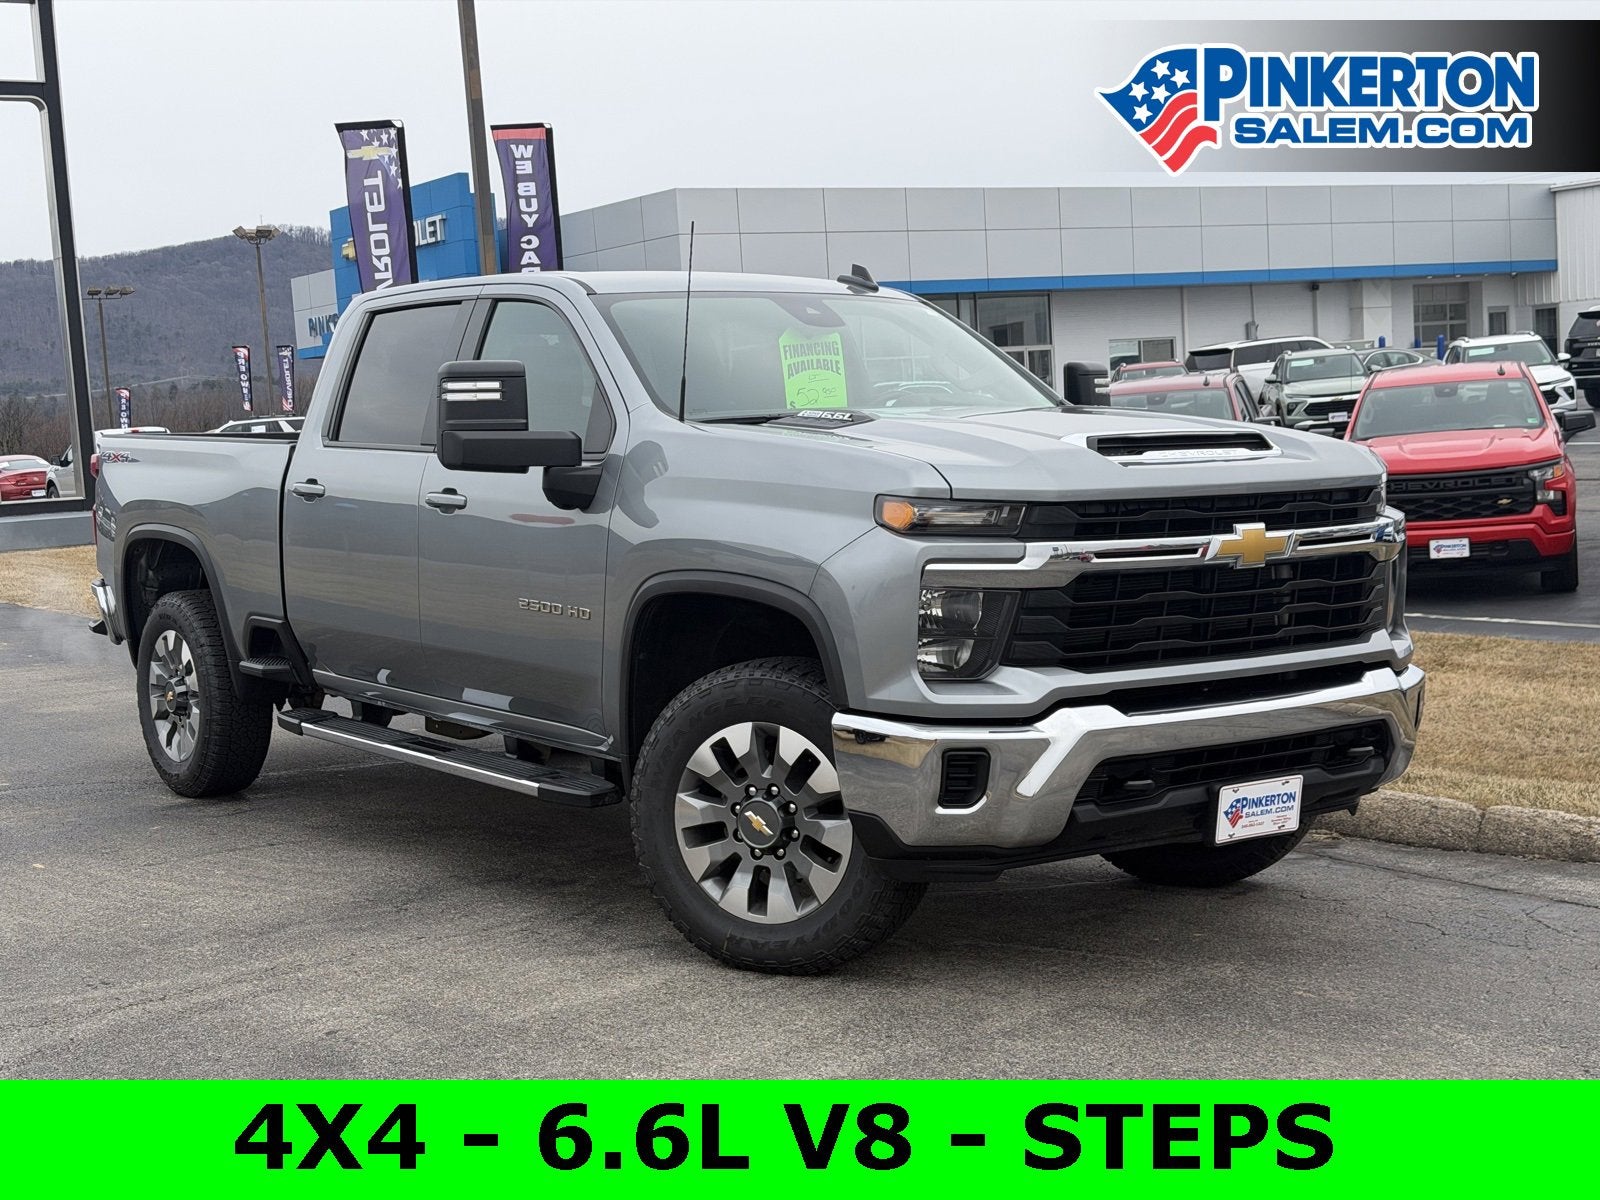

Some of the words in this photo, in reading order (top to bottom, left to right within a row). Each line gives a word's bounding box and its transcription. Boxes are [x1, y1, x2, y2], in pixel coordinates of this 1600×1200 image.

[783, 341, 840, 360] FINANCING
[787, 359, 841, 379] AVAILABLE
[519, 598, 562, 615] 2500
[567, 606, 591, 620] HD
[1240, 791, 1297, 814] PINKERTON
[1245, 805, 1294, 818] SALEM.COM
